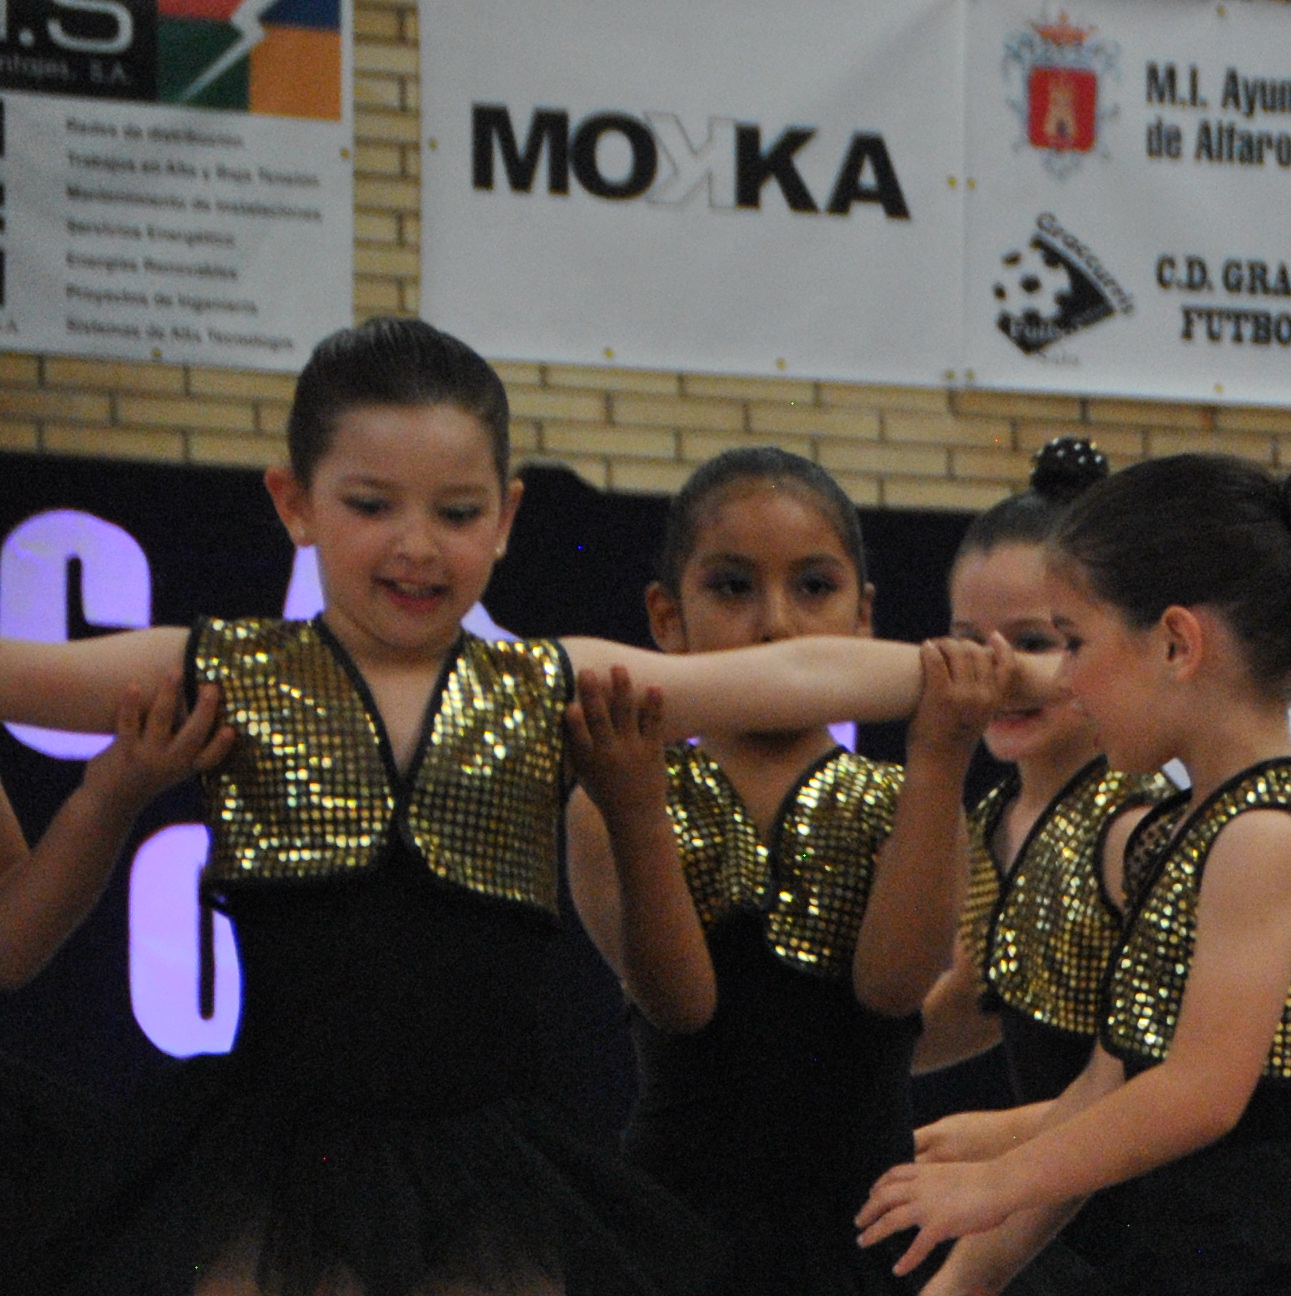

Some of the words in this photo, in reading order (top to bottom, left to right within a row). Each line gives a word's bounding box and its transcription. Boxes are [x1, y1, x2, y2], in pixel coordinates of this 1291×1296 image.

[1146, 61, 1209, 109] M.I.
[1145, 116, 1183, 160] de
[1155, 253, 1214, 296] C.D.
